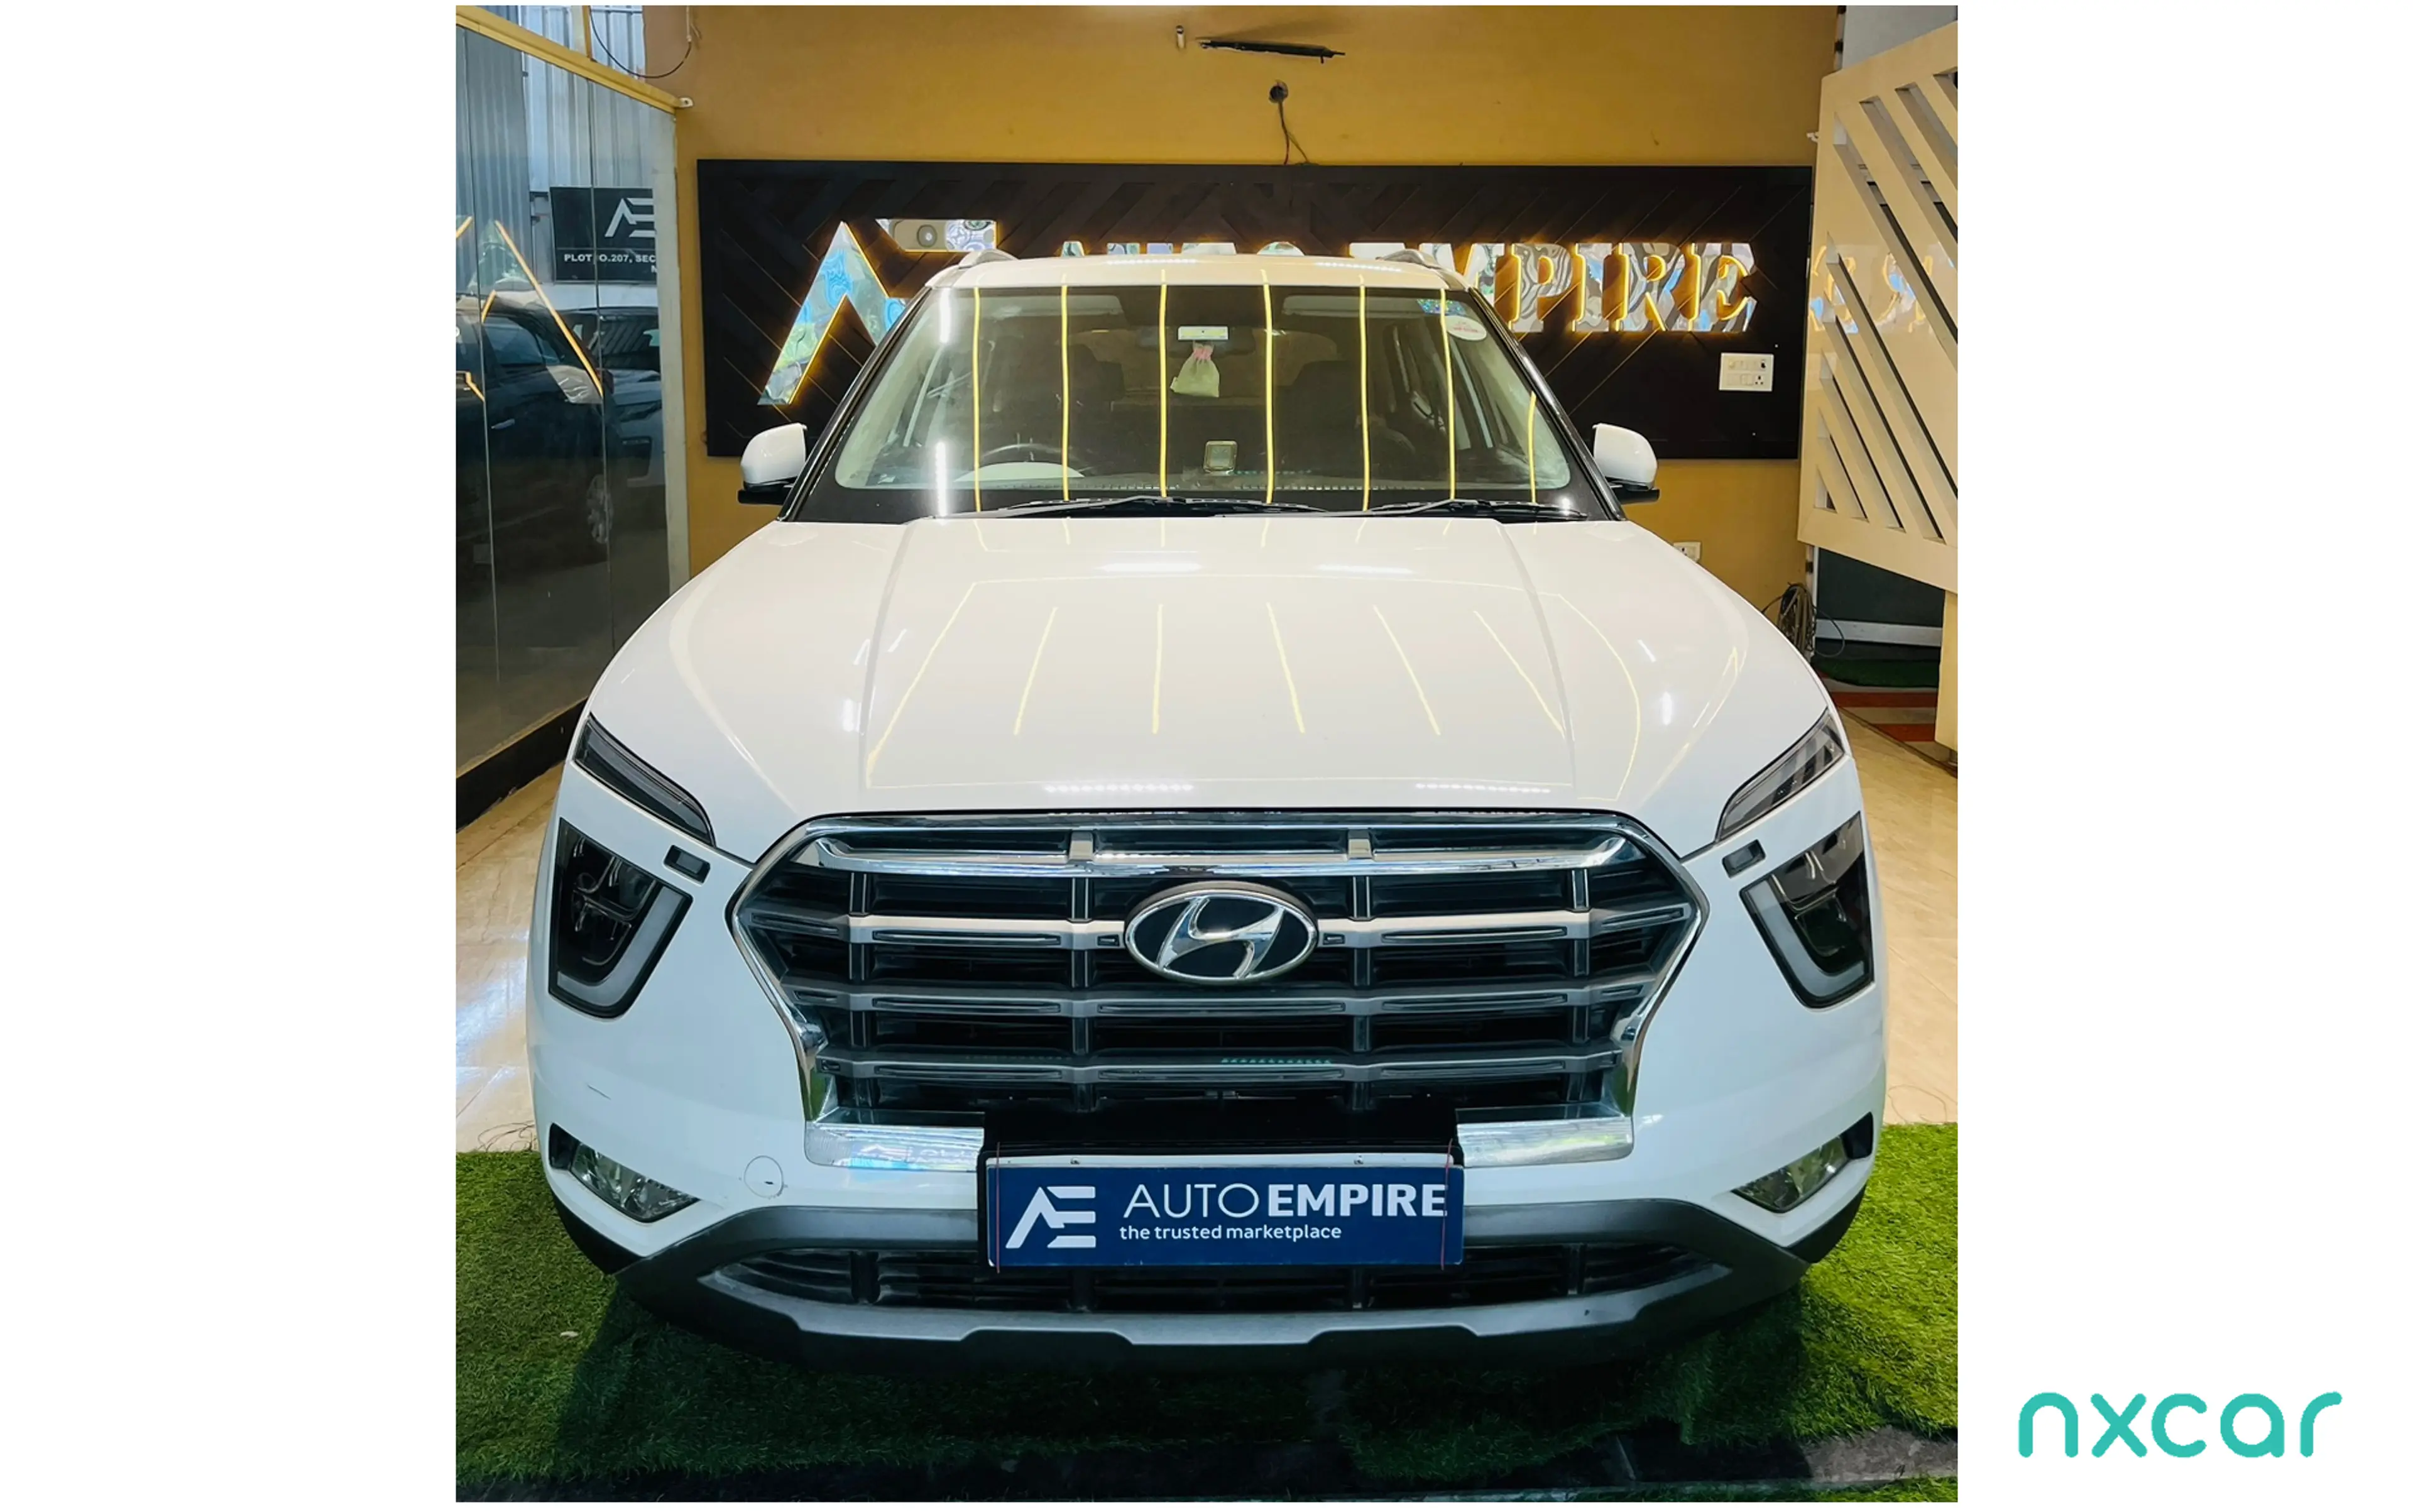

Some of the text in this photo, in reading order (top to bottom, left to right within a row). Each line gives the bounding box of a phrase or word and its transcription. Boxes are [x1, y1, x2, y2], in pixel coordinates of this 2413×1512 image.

[564, 254, 593, 262] PLOT
[594, 254, 633, 263] O.207,
[1123, 1183, 1259, 1218] AUTO
[1267, 1183, 1448, 1217] EMPIRE
[1120, 1224, 1342, 1242] the trusted marketplace
